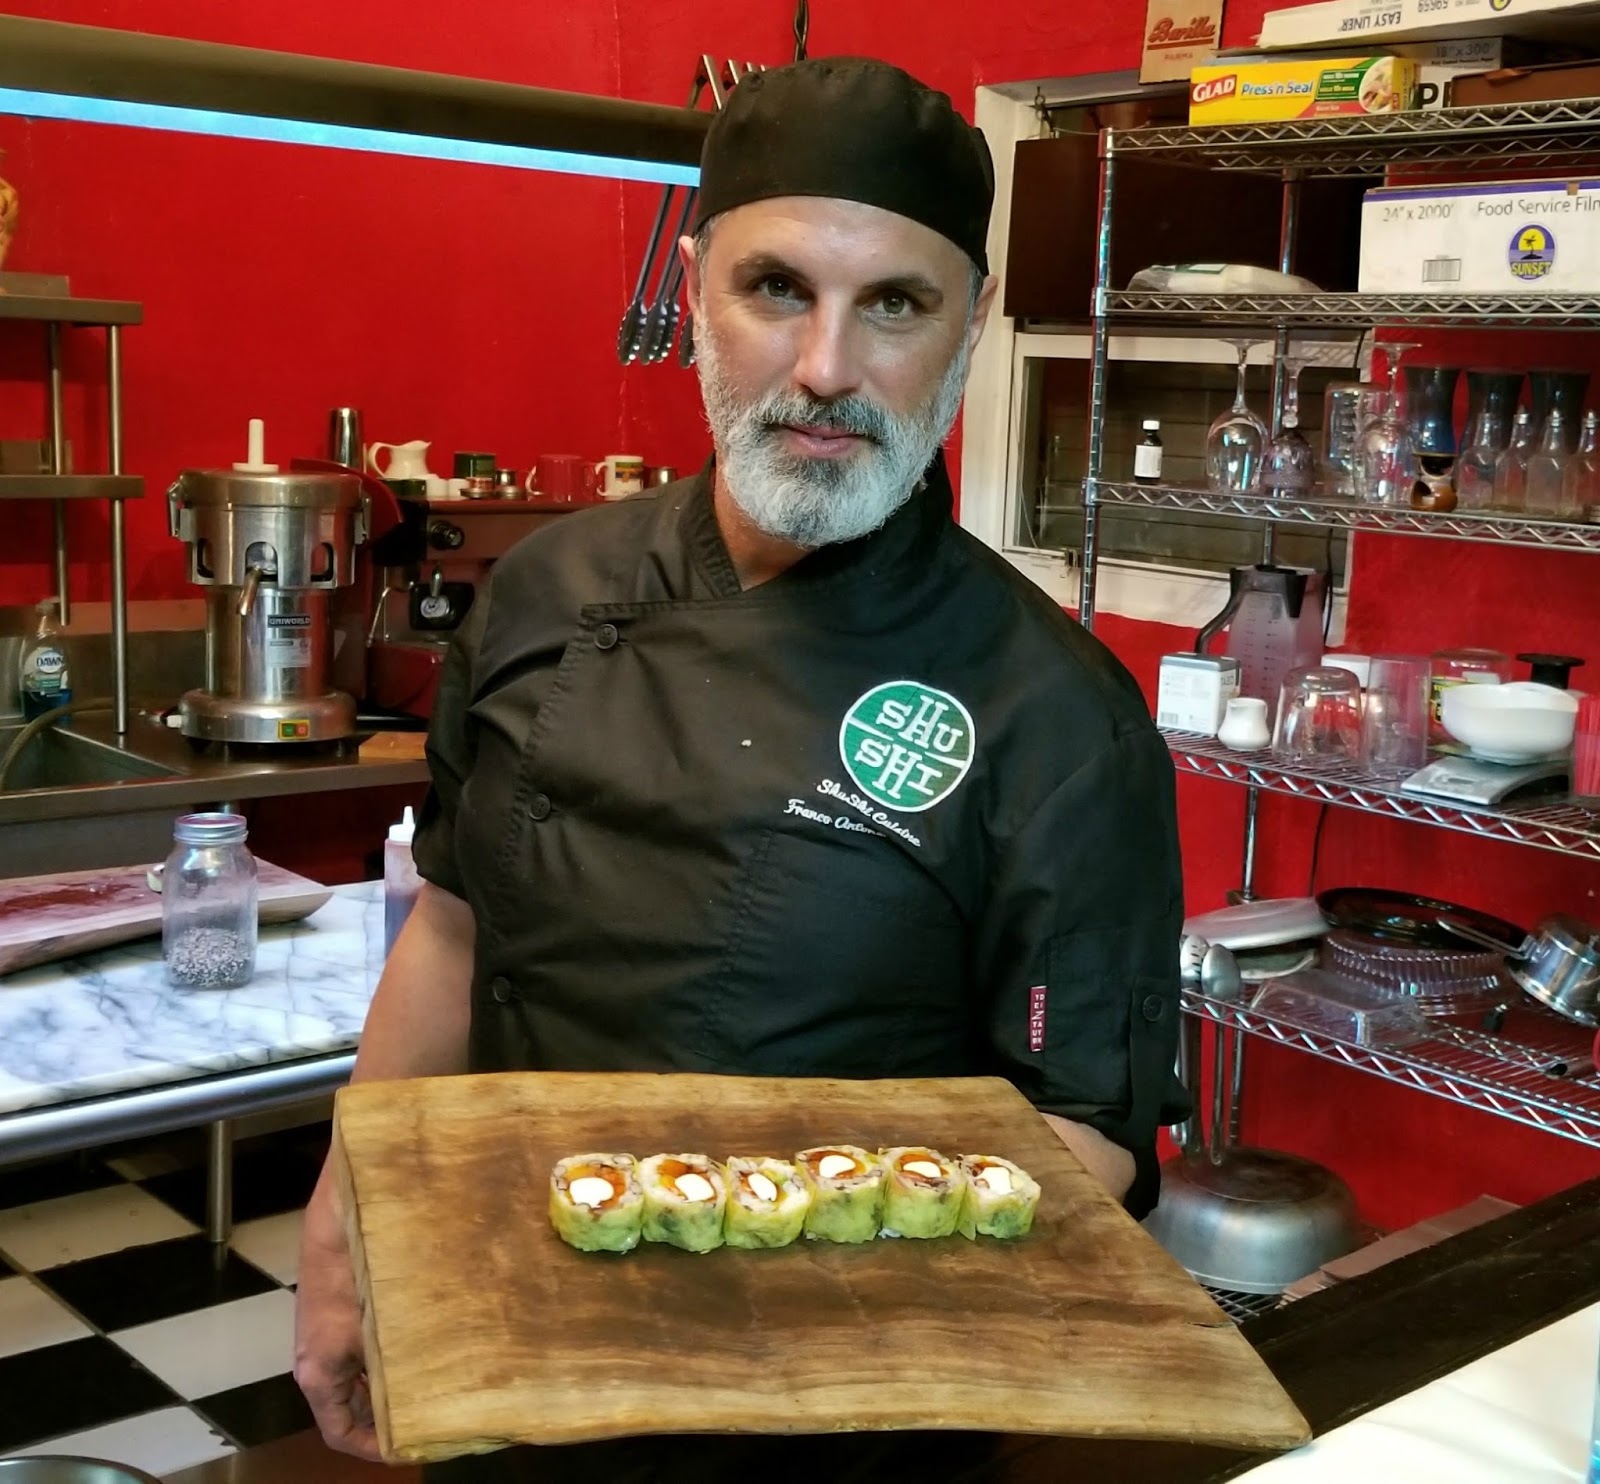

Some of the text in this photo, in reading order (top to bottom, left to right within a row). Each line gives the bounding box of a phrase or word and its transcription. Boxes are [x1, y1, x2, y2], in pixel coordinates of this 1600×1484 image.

[1147, 16, 1216, 43] Barilla
[1341, 11, 1402, 31] EASY LINER
[1192, 77, 1236, 102] GLAD
[1286, 81, 1314, 94] Seal
[1407, 209, 1414, 220] x
[1477, 199, 1513, 217] Food
[1517, 196, 1571, 215] Service
[1510, 260, 1552, 276] SUNSET
[36, 656, 64, 667] DAWN
[876, 694, 964, 753] SHU
[854, 738, 943, 800] SHI
[783, 797, 833, 825] Franco
[872, 812, 921, 848] Cuisine
